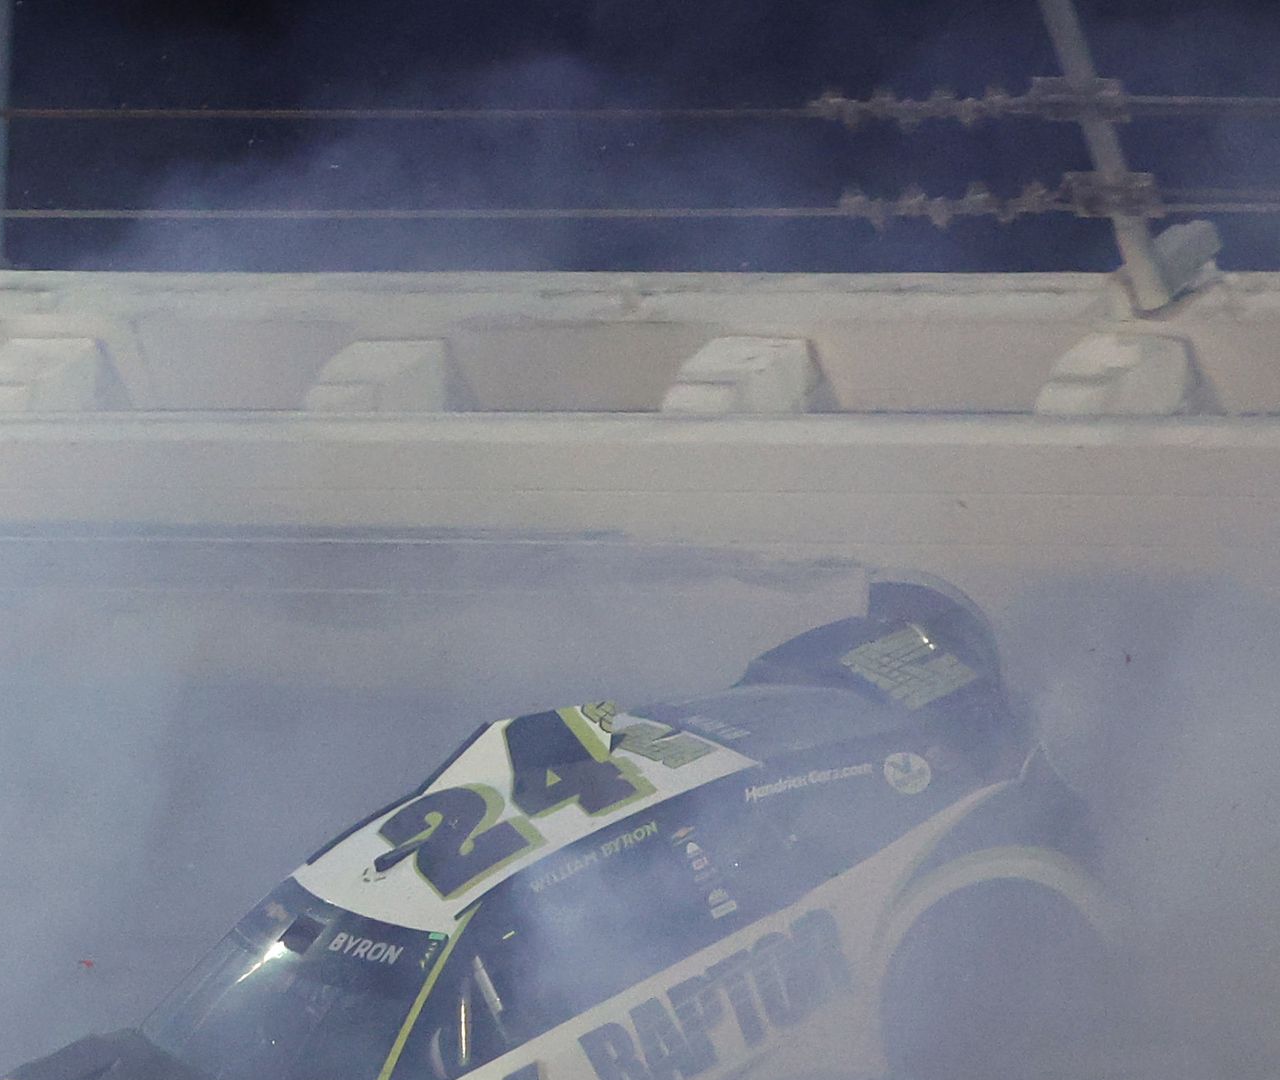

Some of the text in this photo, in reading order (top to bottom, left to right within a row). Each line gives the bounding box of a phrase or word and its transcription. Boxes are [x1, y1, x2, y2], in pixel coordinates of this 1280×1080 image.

[377, 707, 658, 900] 24
[601, 820, 659, 858] BYRON
[328, 932, 404, 965] BYRON
